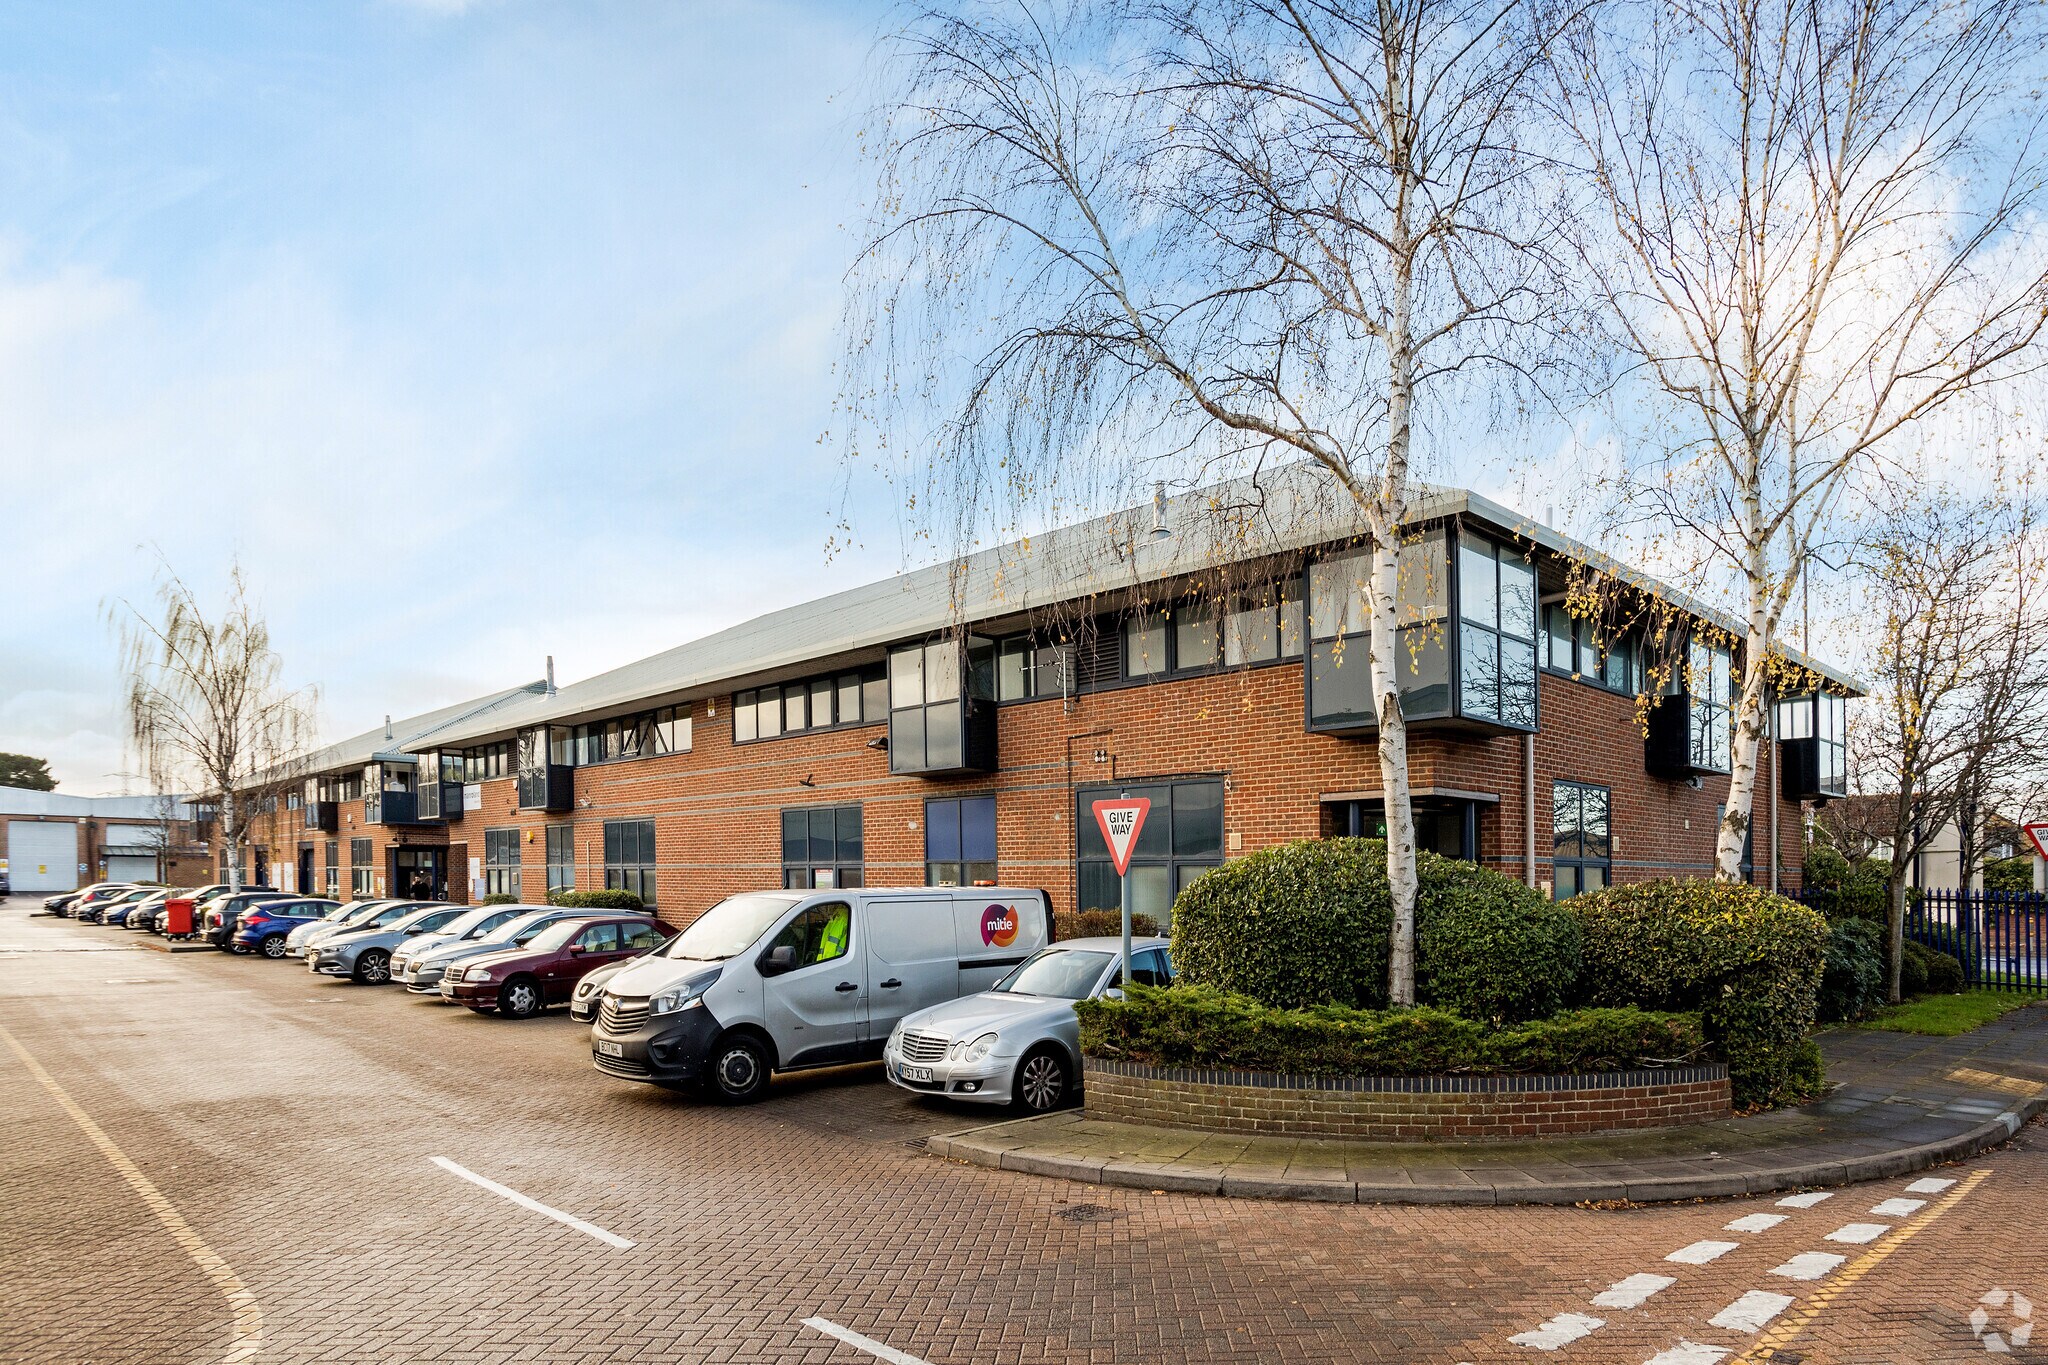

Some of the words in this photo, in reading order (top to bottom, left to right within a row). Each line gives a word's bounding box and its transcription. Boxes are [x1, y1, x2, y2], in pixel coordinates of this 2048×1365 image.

[1109, 811, 1133, 824] GIVE
[1111, 824, 1132, 836] WAY
[987, 917, 1013, 931] mitie
[915, 1069, 931, 1080] XLX
